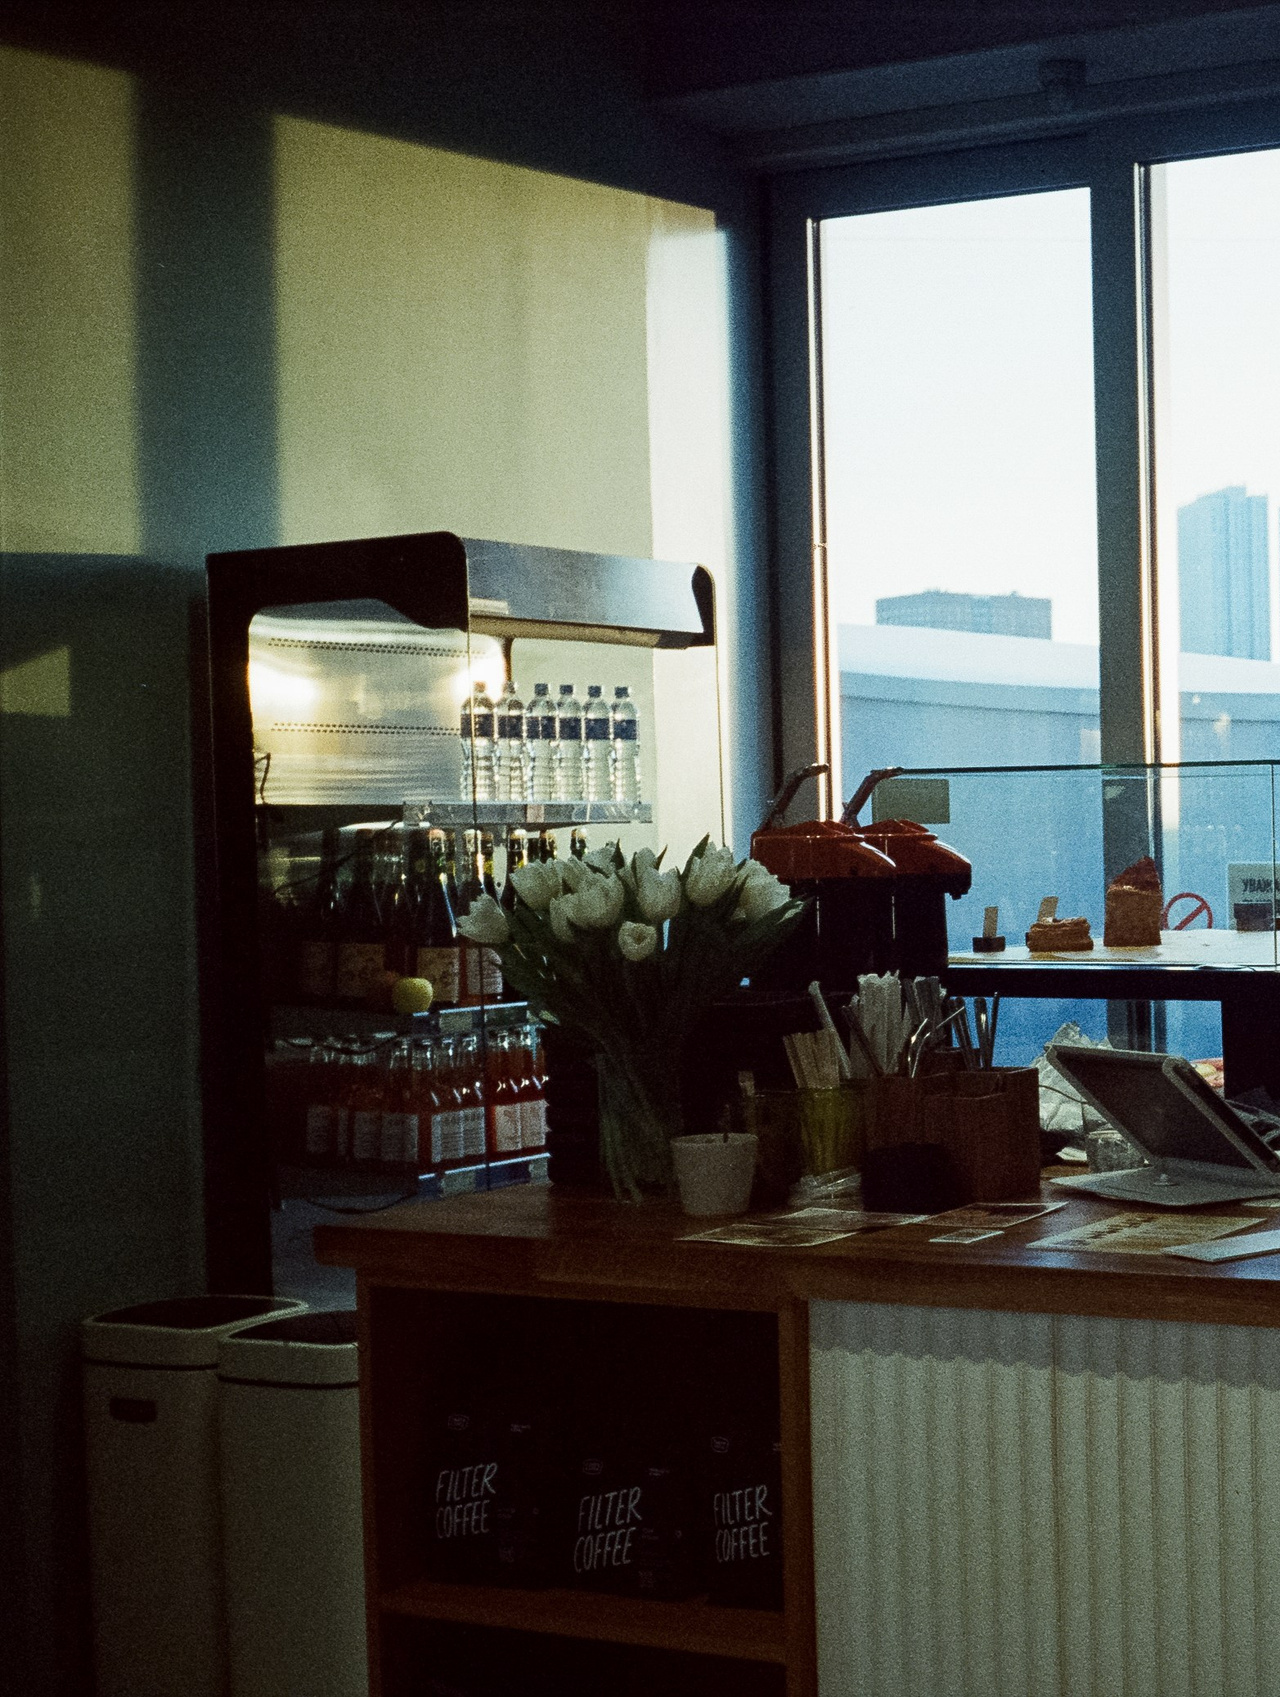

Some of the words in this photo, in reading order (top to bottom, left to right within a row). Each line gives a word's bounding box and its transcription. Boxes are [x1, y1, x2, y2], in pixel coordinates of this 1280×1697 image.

[435, 1462, 498, 1503] FILTER
[435, 1499, 490, 1539] COFFEE
[578, 1486, 643, 1531] FILTER
[713, 1484, 772, 1526] FILTER
[573, 1527, 637, 1573] COFFEE
[715, 1521, 771, 1563] COFFEE
